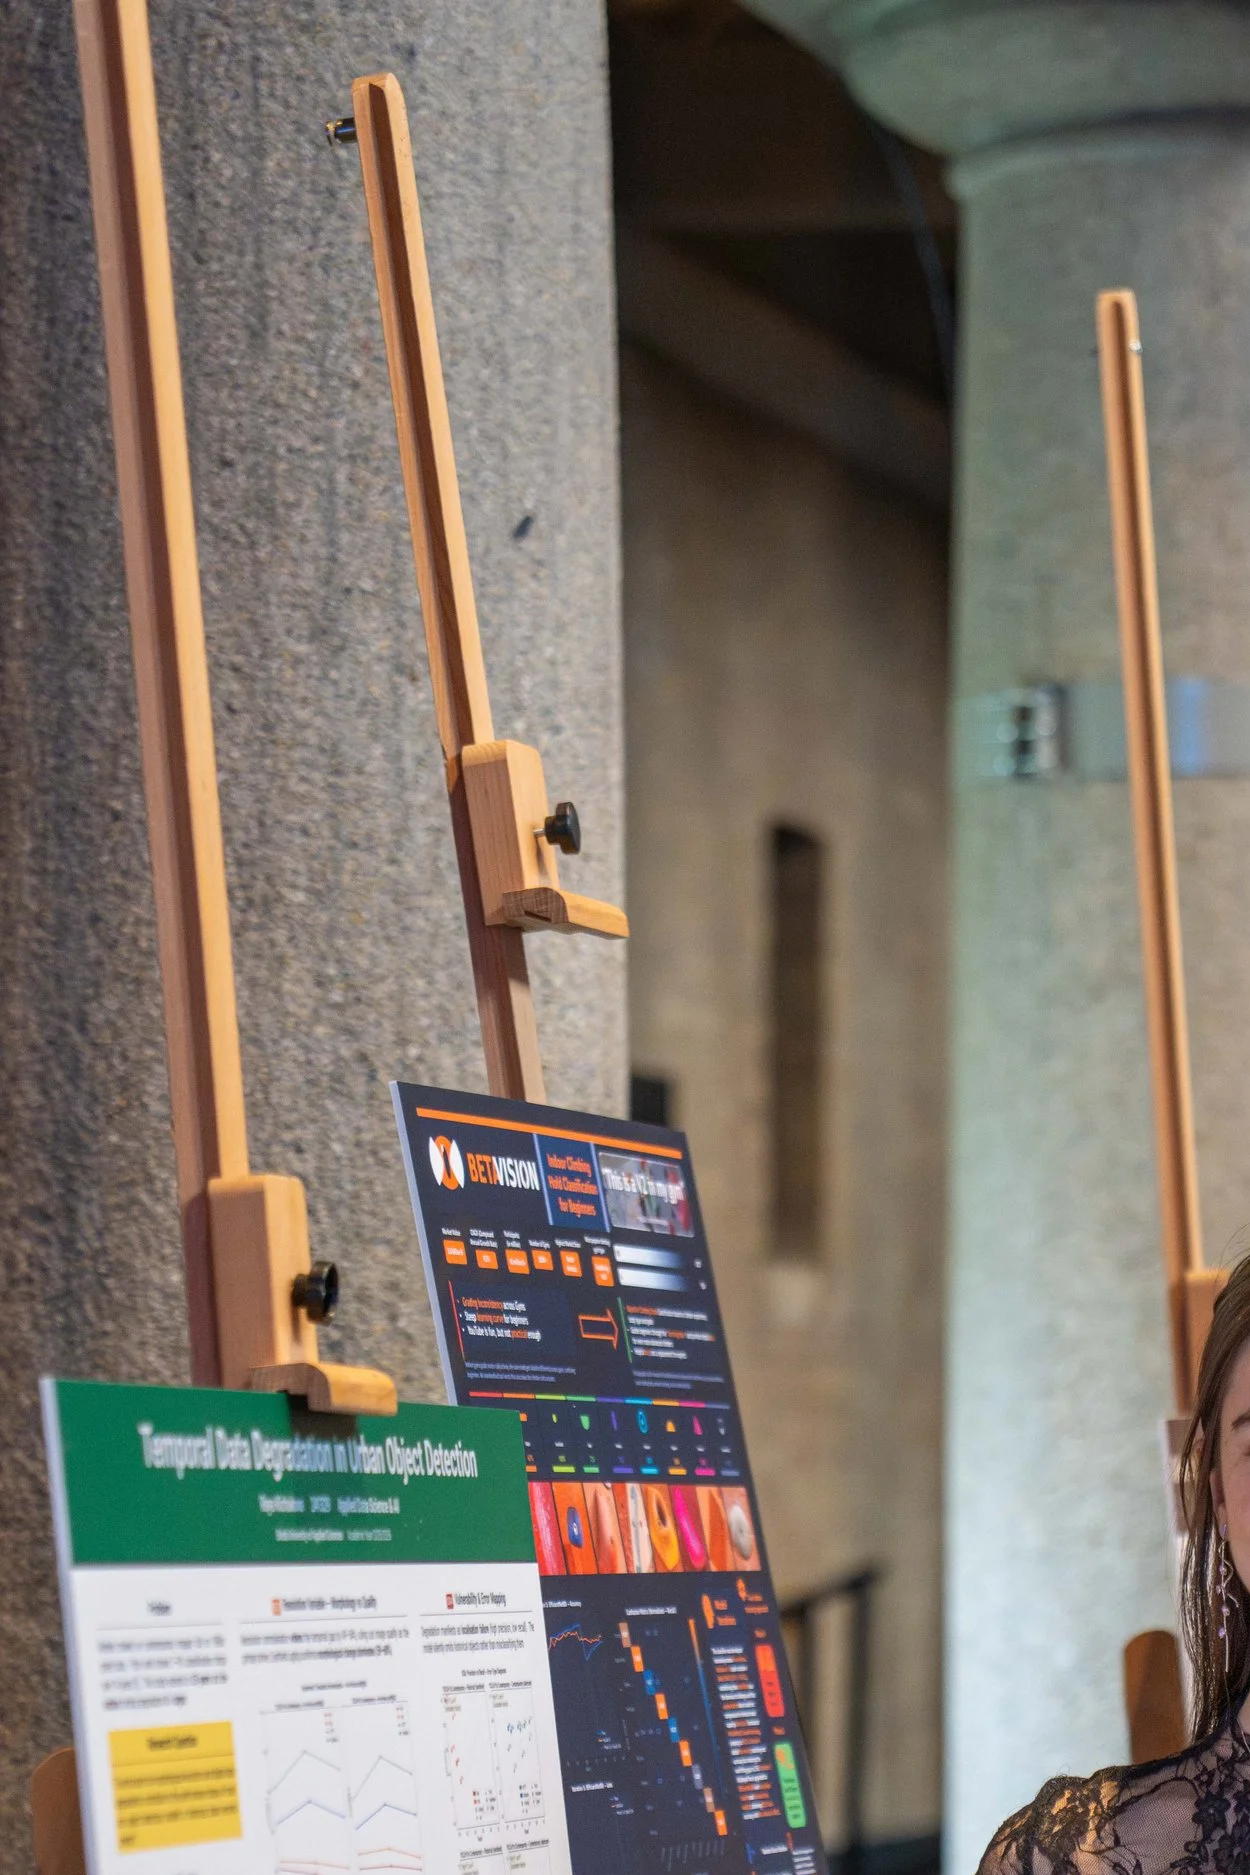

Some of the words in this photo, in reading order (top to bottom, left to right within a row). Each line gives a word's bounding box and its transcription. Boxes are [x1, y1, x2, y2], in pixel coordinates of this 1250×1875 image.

[466, 1152, 540, 1191] BETAVISION
[546, 1153, 566, 1170] Indoor
[566, 1156, 592, 1178] Climbing
[547, 1175, 562, 1190] Hold
[562, 1176, 598, 1195] Classification
[557, 1197, 568, 1212] for
[568, 1198, 596, 1217] Beginners
[462, 1297, 478, 1310] Grading
[464, 1311, 477, 1323] Steep
[477, 1313, 493, 1325] learning
[493, 1315, 504, 1324] curve
[510, 1315, 529, 1327] beginners
[467, 1325, 484, 1336] YouTube
[528, 1331, 542, 1342] enough
[138, 1422, 216, 1480] Temporal
[215, 1426, 252, 1470] Data
[251, 1427, 333, 1482] Degradation
[334, 1436, 348, 1472] in
[347, 1434, 385, 1474] Urban
[385, 1435, 425, 1485] Object
[424, 1440, 478, 1478] Detection
[455, 1592, 477, 1608] Vulnerability
[481, 1592, 489, 1604] Error
[490, 1591, 506, 1606] Mapping
